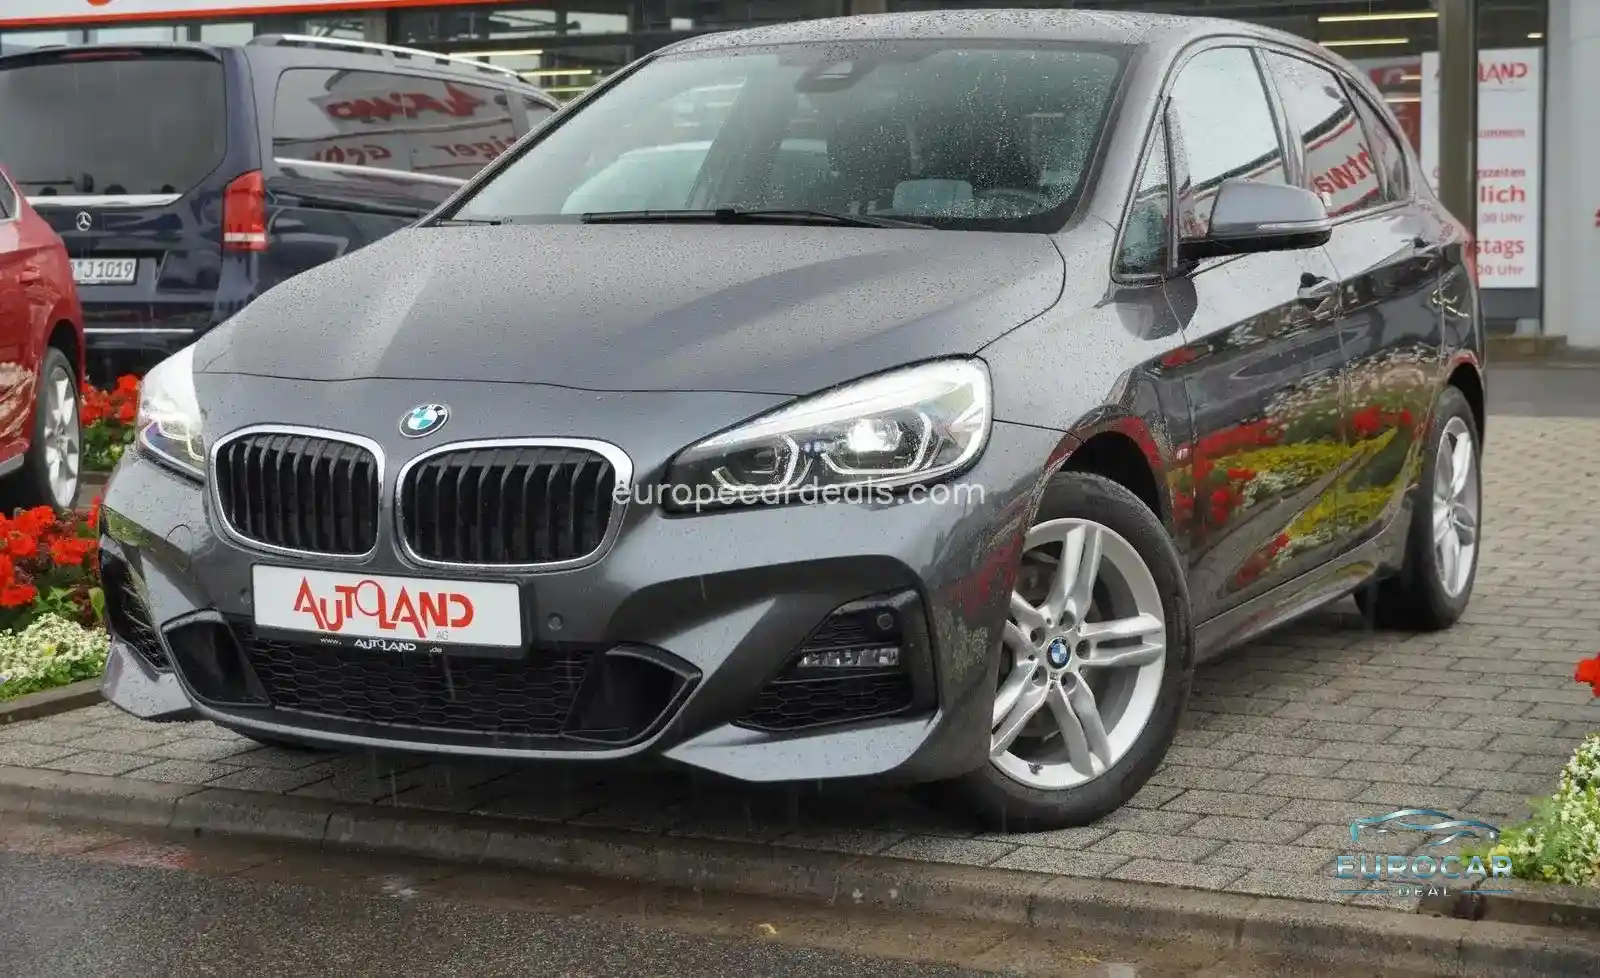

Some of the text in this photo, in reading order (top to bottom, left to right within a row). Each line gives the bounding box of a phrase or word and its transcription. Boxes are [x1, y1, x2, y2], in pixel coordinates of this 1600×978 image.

[1480, 185, 1526, 203] lich
[1501, 212, 1524, 223] Uhr
[1475, 240, 1525, 259] stags
[96, 261, 133, 278] 1019
[1497, 264, 1525, 277] Uhr
[294, 576, 474, 638] AUTOLAND
[435, 629, 449, 640] AG
